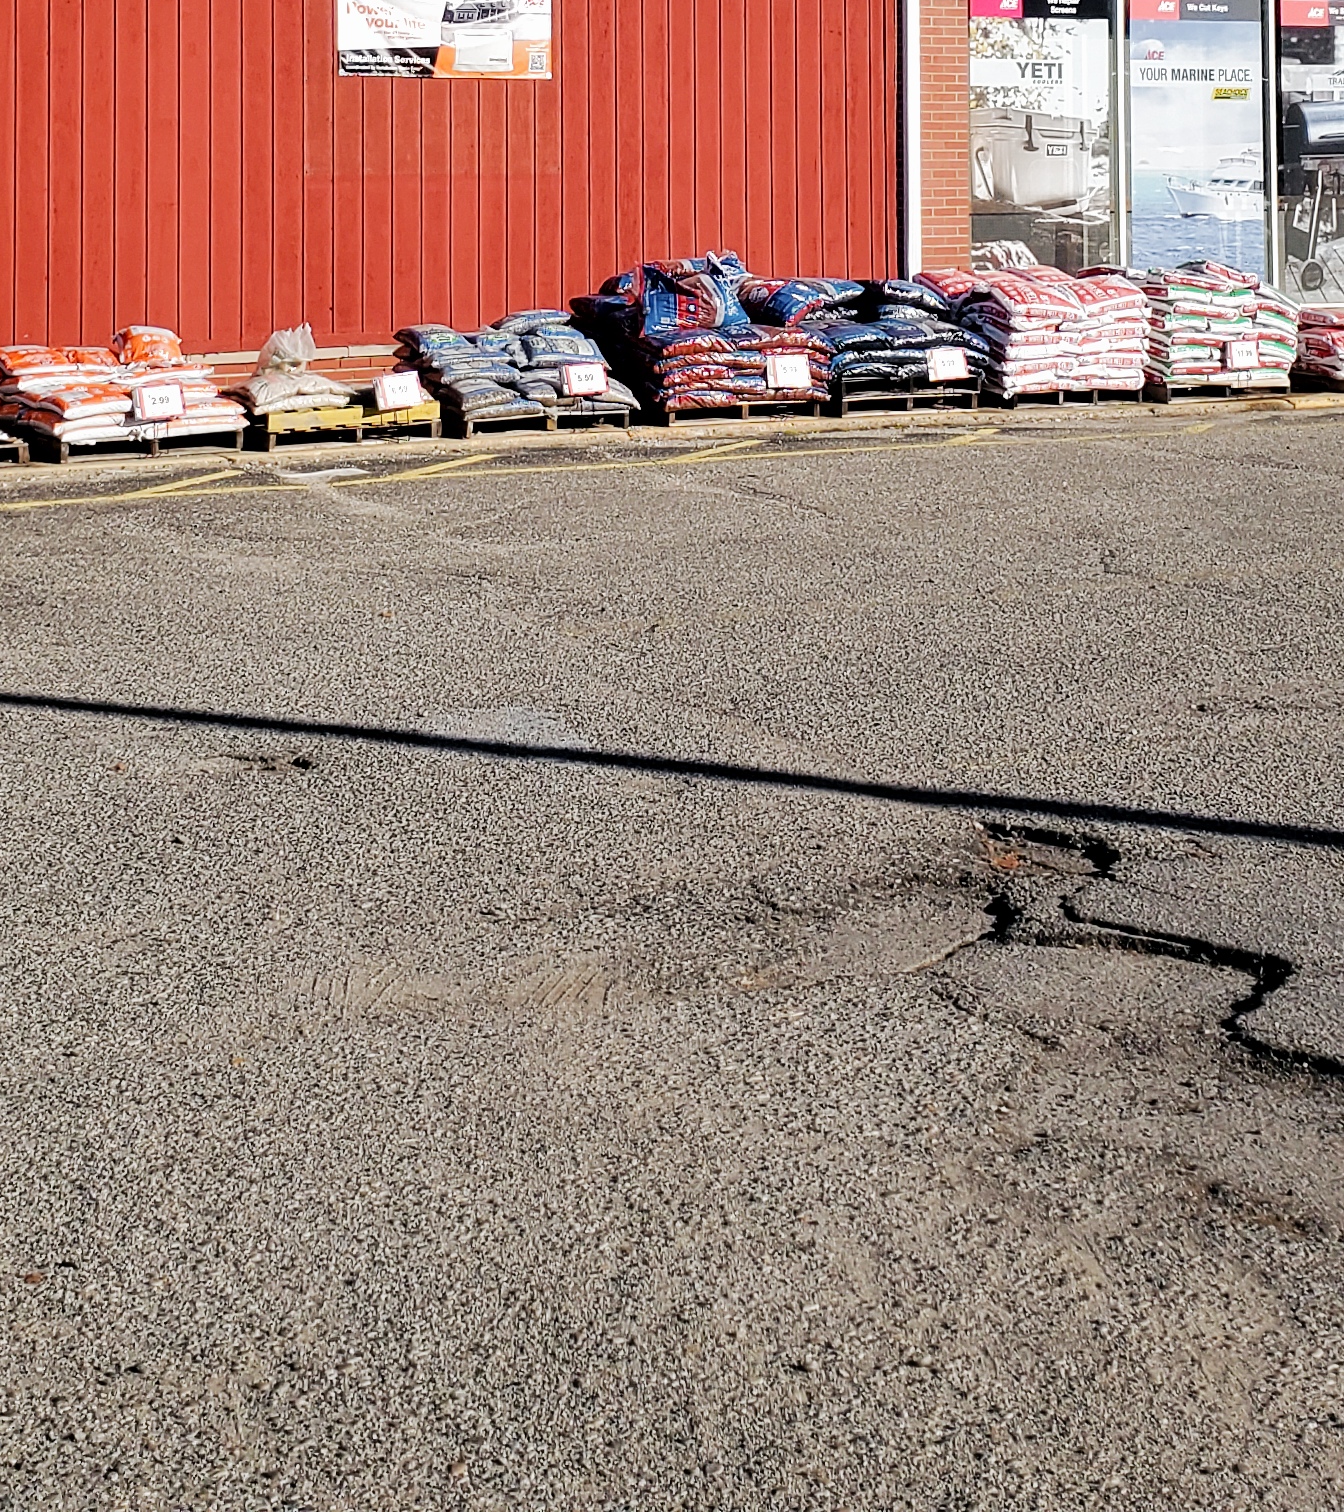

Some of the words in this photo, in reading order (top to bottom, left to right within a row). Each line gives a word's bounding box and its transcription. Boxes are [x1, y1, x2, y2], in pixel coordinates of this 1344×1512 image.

[1158, 0, 1176, 13] ACE
[1186, 3, 1198, 11] We
[1308, 6, 1325, 19] ACE
[1328, 7, 1339, 16] We
[346, 53, 393, 64] Installation
[394, 55, 431, 65] Services
[1145, 49, 1165, 60] ACE
[1016, 62, 1063, 79] YETI
[1139, 67, 1168, 81] YOUR
[1171, 68, 1215, 82] MARINE
[1218, 68, 1253, 82] PLACE.
[1047, 145, 1067, 155] YETI
